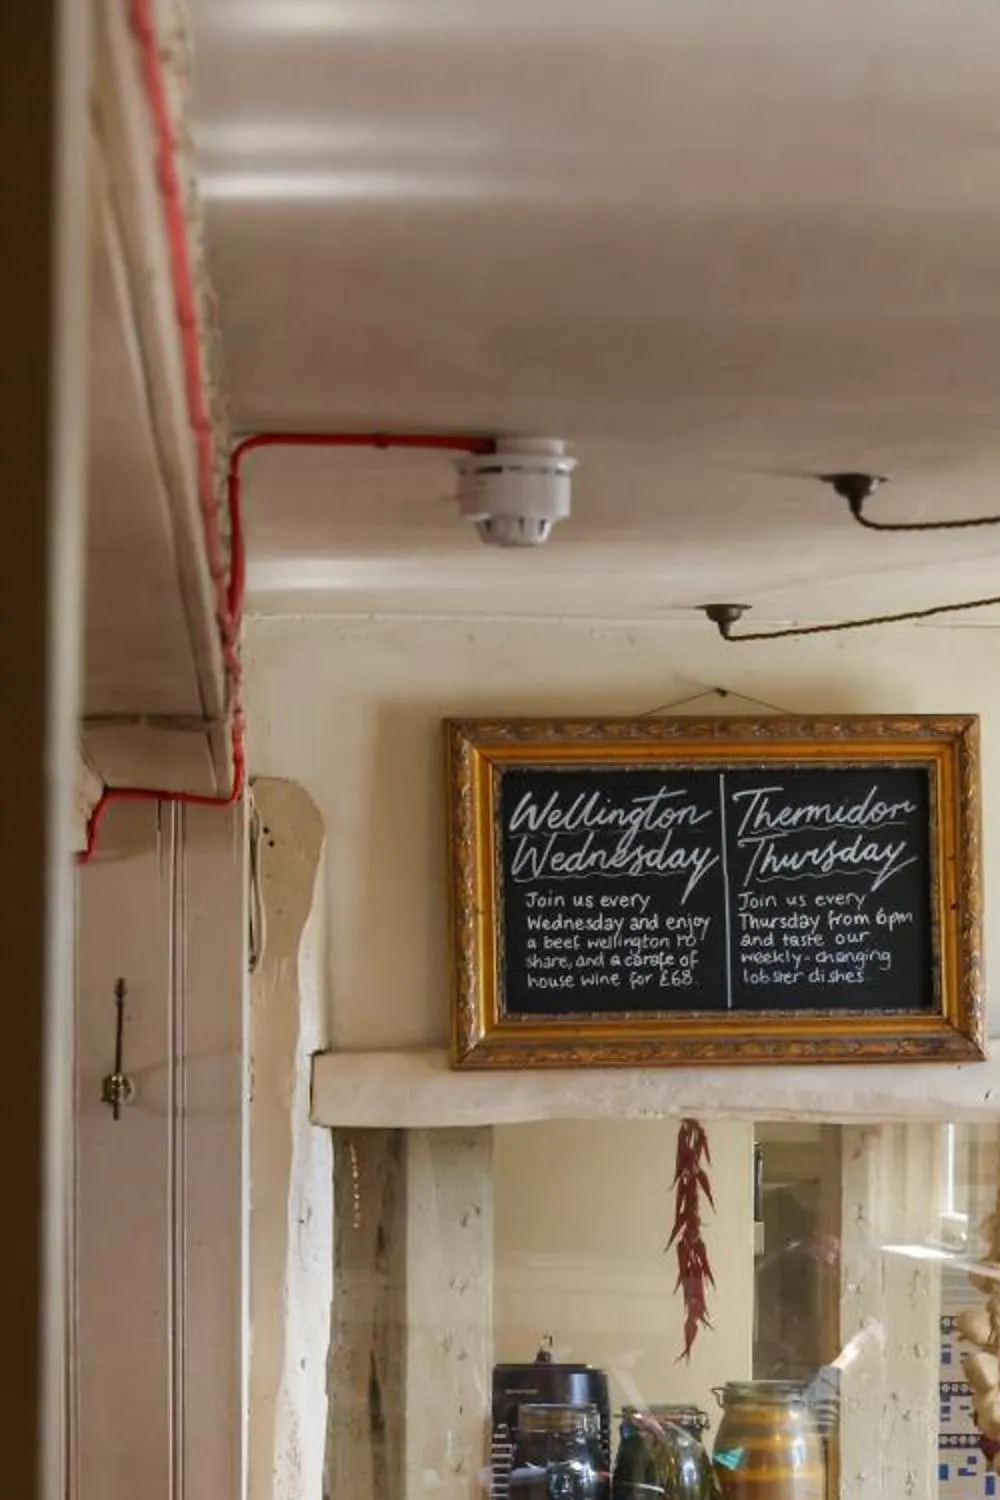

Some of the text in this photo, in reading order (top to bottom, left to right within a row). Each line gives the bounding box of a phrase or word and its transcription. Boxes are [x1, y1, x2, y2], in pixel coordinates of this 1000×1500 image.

[509, 785, 712, 846] Wellington
[732, 785, 917, 836] Thermidor
[511, 832, 719, 905] Wednesday
[737, 834, 919, 892] Thursday
[525, 891, 651, 913] Join us every
[738, 892, 866, 911] Join us every
[527, 912, 711, 941] Wednesday and enjoy
[738, 908, 913, 934] Thursday from 6pm
[527, 934, 697, 955] a beef wellington to
[740, 931, 871, 947] and taste our
[576, 953, 605, 967] and
[610, 955, 621, 966] a
[625, 951, 674, 970] carafe
[679, 950, 699, 969] of
[527, 971, 575, 989] house
[581, 973, 620, 986] wine
[629, 971, 653, 989] for
[743, 969, 803, 984] lobster
